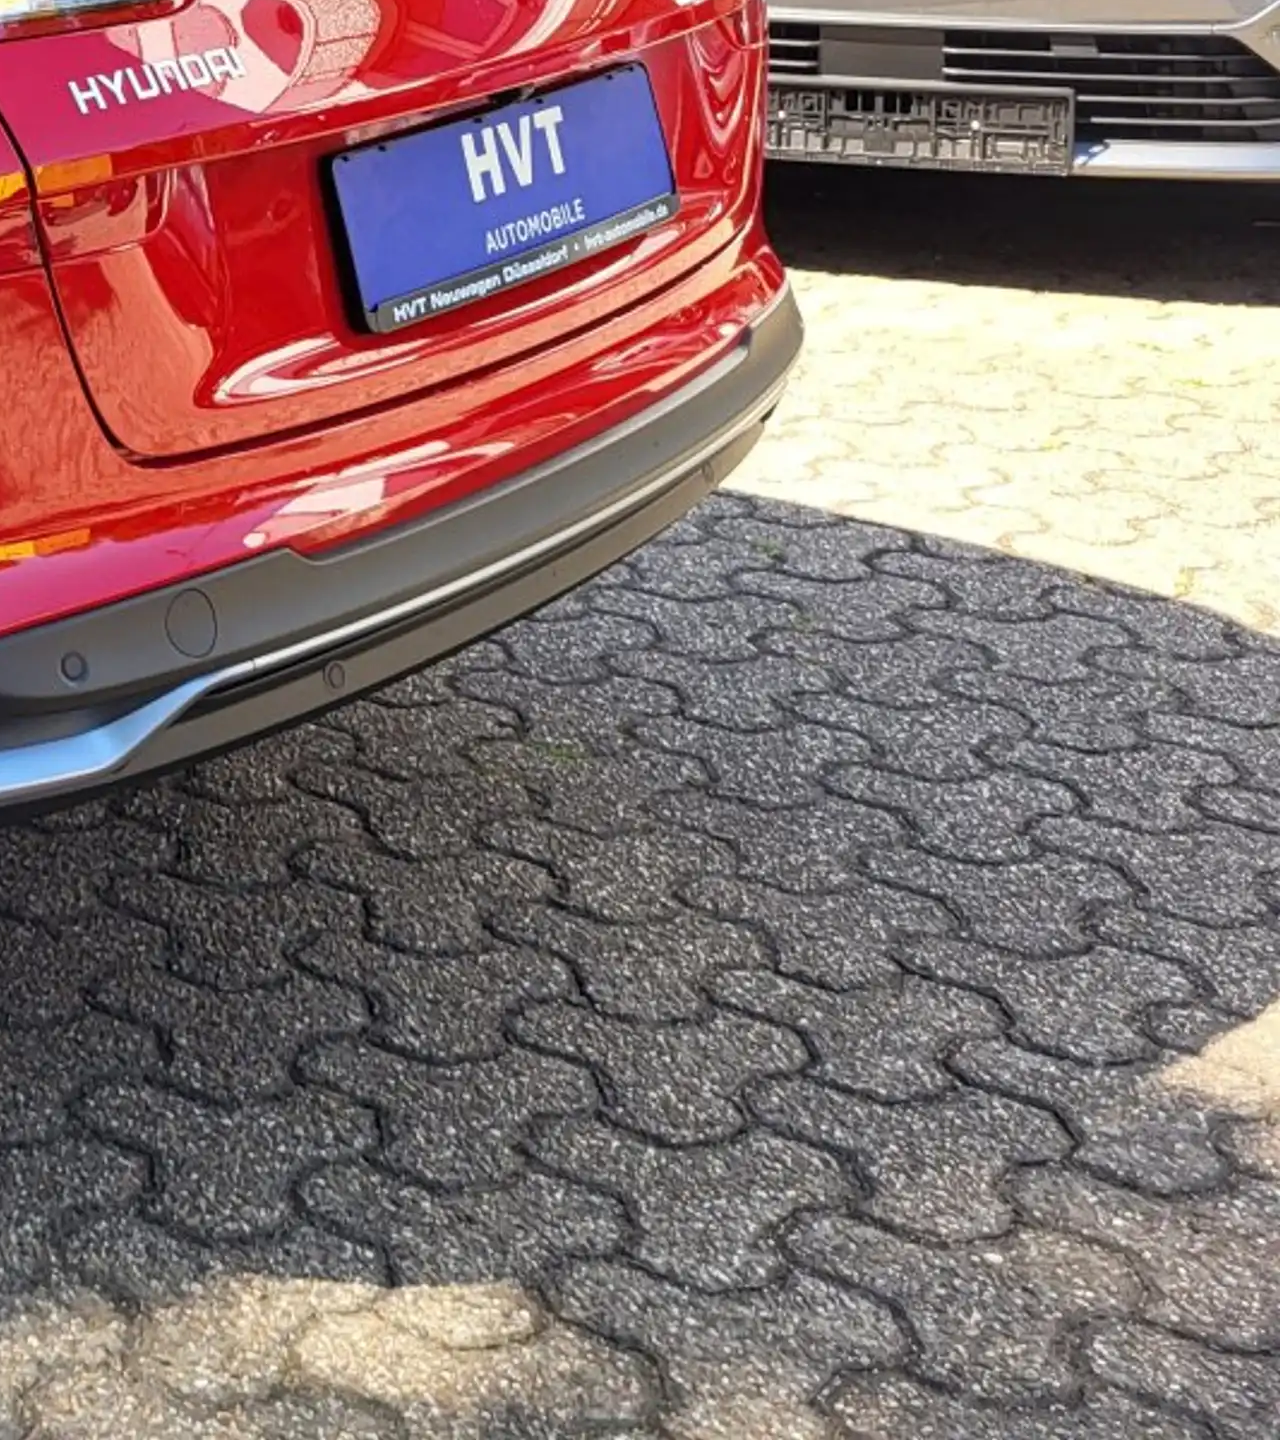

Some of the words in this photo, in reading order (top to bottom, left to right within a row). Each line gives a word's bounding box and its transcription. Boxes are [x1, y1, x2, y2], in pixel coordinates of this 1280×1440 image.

[67, 46, 248, 115] HYUNDAI
[460, 105, 567, 203] HVT
[485, 197, 586, 255] AUTOMOBILE
[393, 296, 427, 323] HVT
[430, 273, 502, 310] Neuwagen
